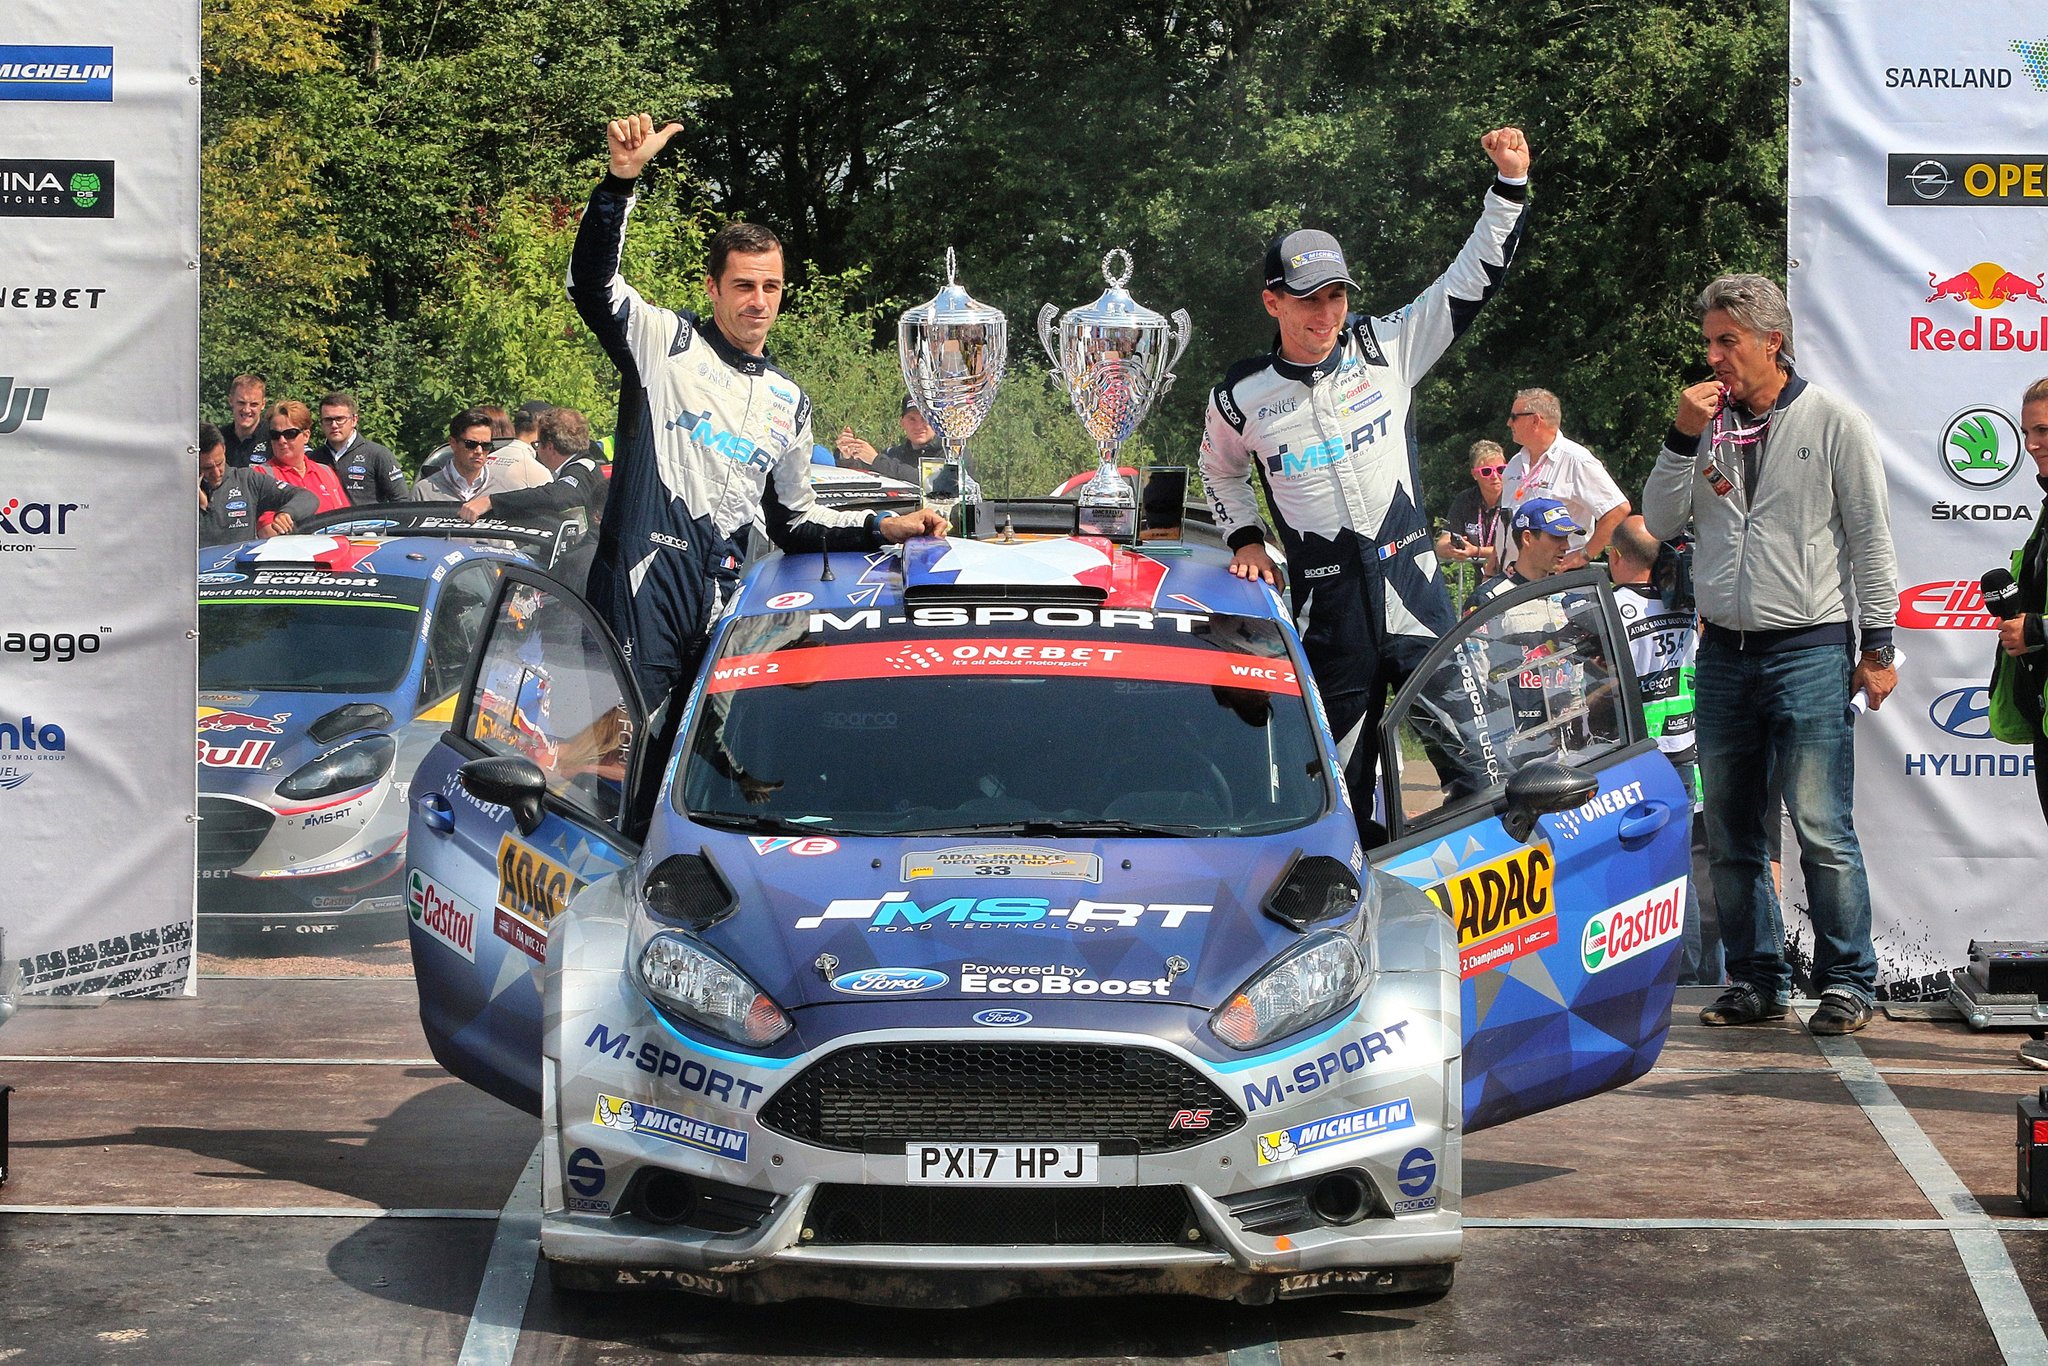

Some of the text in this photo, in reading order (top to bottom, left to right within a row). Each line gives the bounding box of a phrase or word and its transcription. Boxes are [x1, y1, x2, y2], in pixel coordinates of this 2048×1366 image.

[1885, 67, 2012, 89] SAARLAND
[0, 286, 106, 309] EBET
[1357, 324, 1380, 360] sparco
[1910, 316, 1983, 351] Red
[1346, 380, 1372, 399] Castrol
[1219, 389, 1242, 426] sparco
[1269, 401, 1298, 417] NICE
[1281, 409, 1392, 478] MS-RT
[1931, 500, 2033, 521] ŠKODA
[420, 521, 554, 538] EcoBoost
[1396, 527, 1428, 549] CAMILLI
[649, 531, 689, 550] sparco
[257, 570, 314, 578] Powered
[1304, 563, 1342, 578] sparco
[253, 575, 380, 587] EcoBoost
[199, 589, 232, 597] World
[234, 589, 263, 597] Rally
[265, 589, 345, 598] Championship
[808, 606, 1213, 634] M-SPORT
[1630, 622, 1650, 636] ADAC
[1649, 618, 1667, 630] RALLY
[952, 645, 1123, 662] ONEBET
[714, 663, 780, 681] WRC 2
[1025, 660, 1089, 668] motorsport
[1230, 664, 1297, 683] WRC 2
[823, 711, 898, 730] sparco
[1578, 780, 1646, 823] ONEBET
[311, 808, 353, 828] MS-RT
[803, 840, 828, 853] E
[992, 853, 1067, 862] RALLYE
[974, 865, 1012, 876] 33
[1457, 849, 1551, 944] ADAC
[423, 884, 475, 954] Castrol
[870, 896, 1215, 929] MS-RT
[1608, 886, 1680, 959] Castrol
[867, 921, 1114, 934] ROAD TECHNOLOGY
[1462, 958, 1469, 972] 2
[1468, 941, 1515, 969] Championship
[845, 971, 928, 992] Ford
[960, 962, 1087, 981] Powered by
[960, 974, 1171, 997] EcoBoost
[985, 1010, 1021, 1025] Ford
[585, 1023, 764, 1110] M-SPORT
[1242, 1019, 1410, 1113] M-SPORT
[1168, 1109, 1214, 1130] RS
[1298, 1102, 1408, 1146] MICHELIN
[641, 1110, 745, 1152] MICHELIN
[920, 1147, 1085, 1180] PX17 HPJ
[569, 1198, 610, 1211] sparco
[1394, 1196, 1438, 1212] sparco
